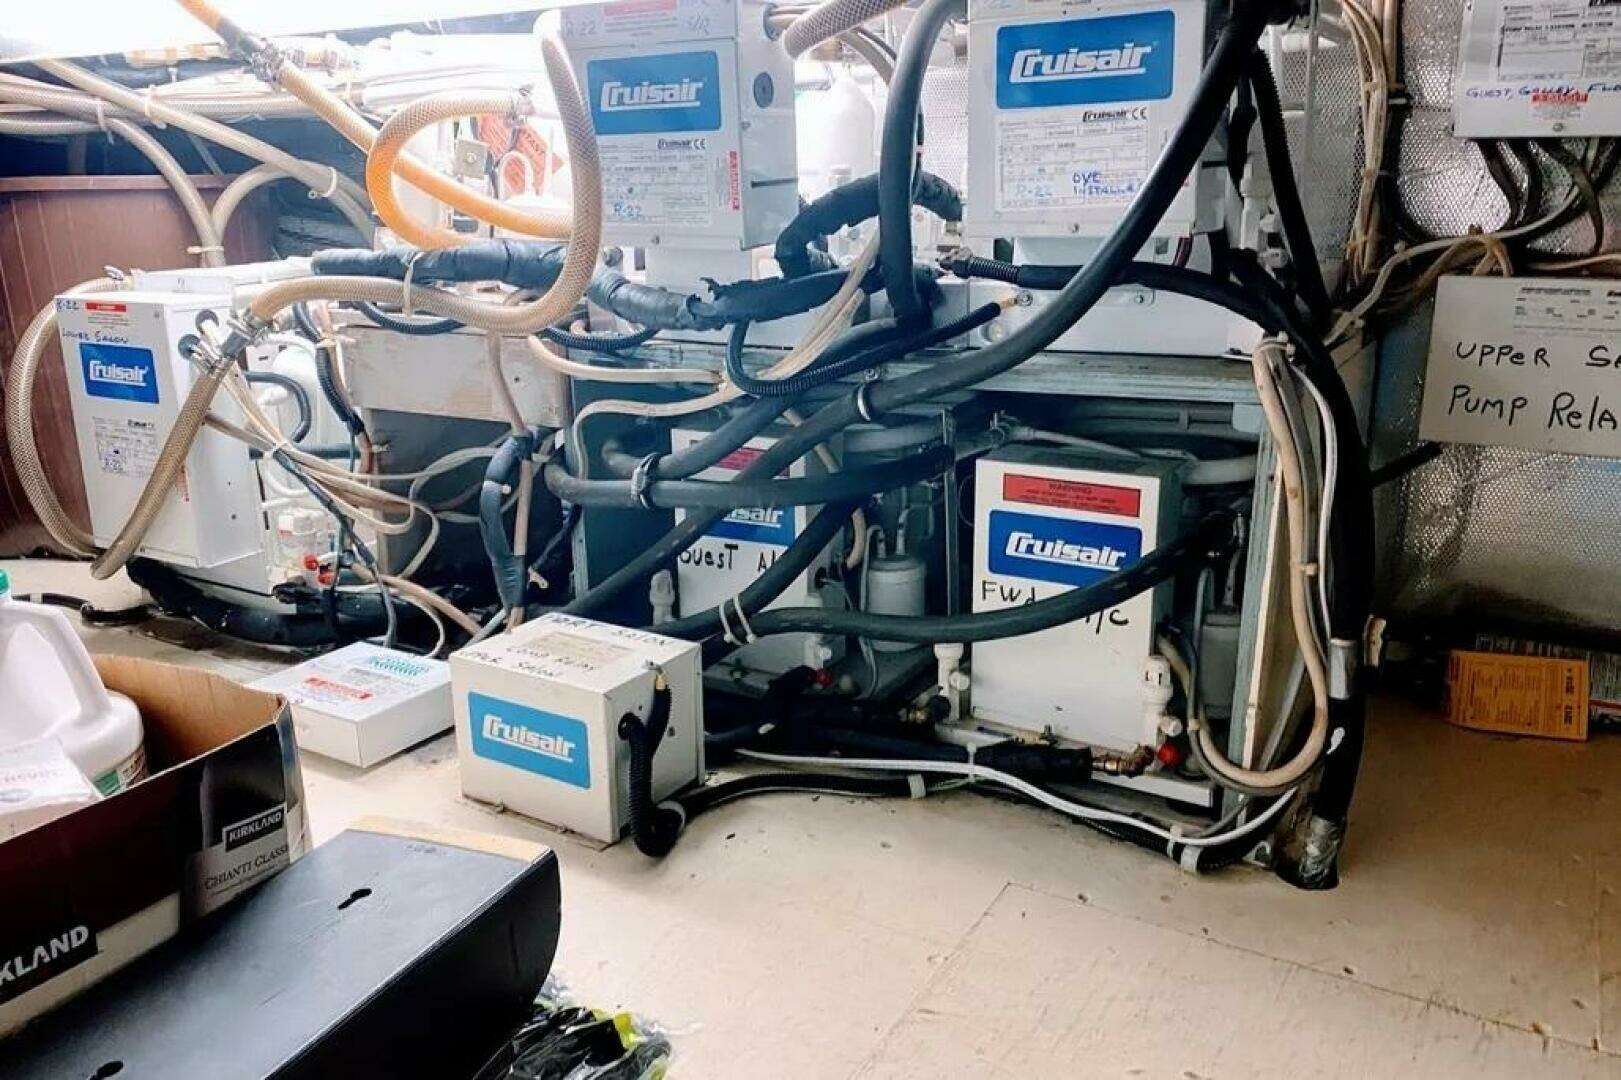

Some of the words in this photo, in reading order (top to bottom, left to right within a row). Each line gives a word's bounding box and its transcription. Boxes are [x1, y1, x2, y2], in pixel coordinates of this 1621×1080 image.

[1008, 41, 1152, 84] Cruisair
[600, 78, 704, 112] Cruisair
[89, 359, 148, 387] Cruisair
[1005, 530, 1126, 571] Cruisair
[1084, 609, 1130, 635] /C
[482, 713, 577, 763] Cruisair
[229, 812, 282, 842] KIRKLAND
